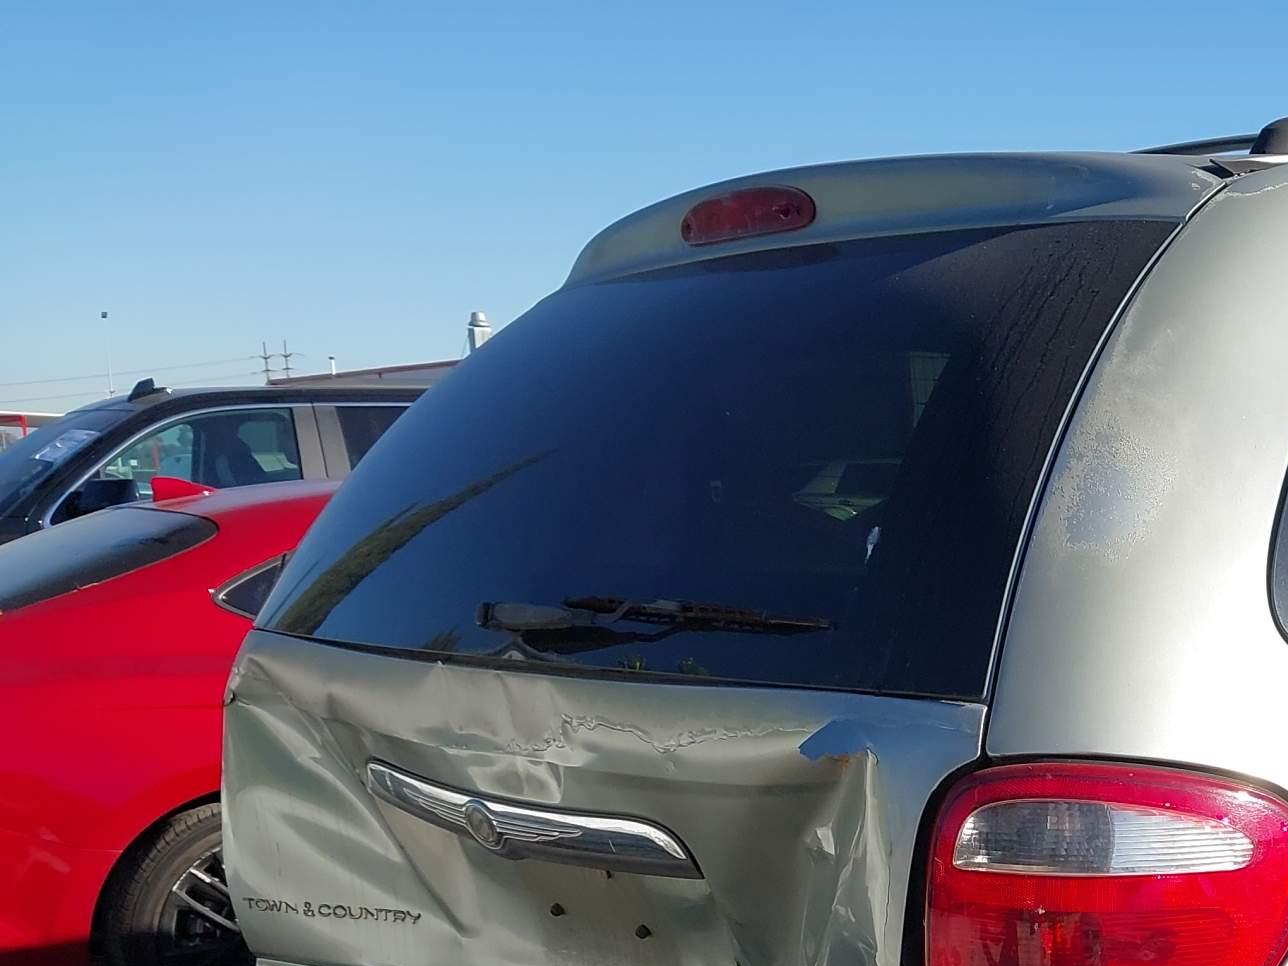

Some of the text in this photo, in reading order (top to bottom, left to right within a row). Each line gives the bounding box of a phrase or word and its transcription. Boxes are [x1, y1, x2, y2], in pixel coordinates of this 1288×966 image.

[242, 897, 422, 925] TOWN & COUNTRY
